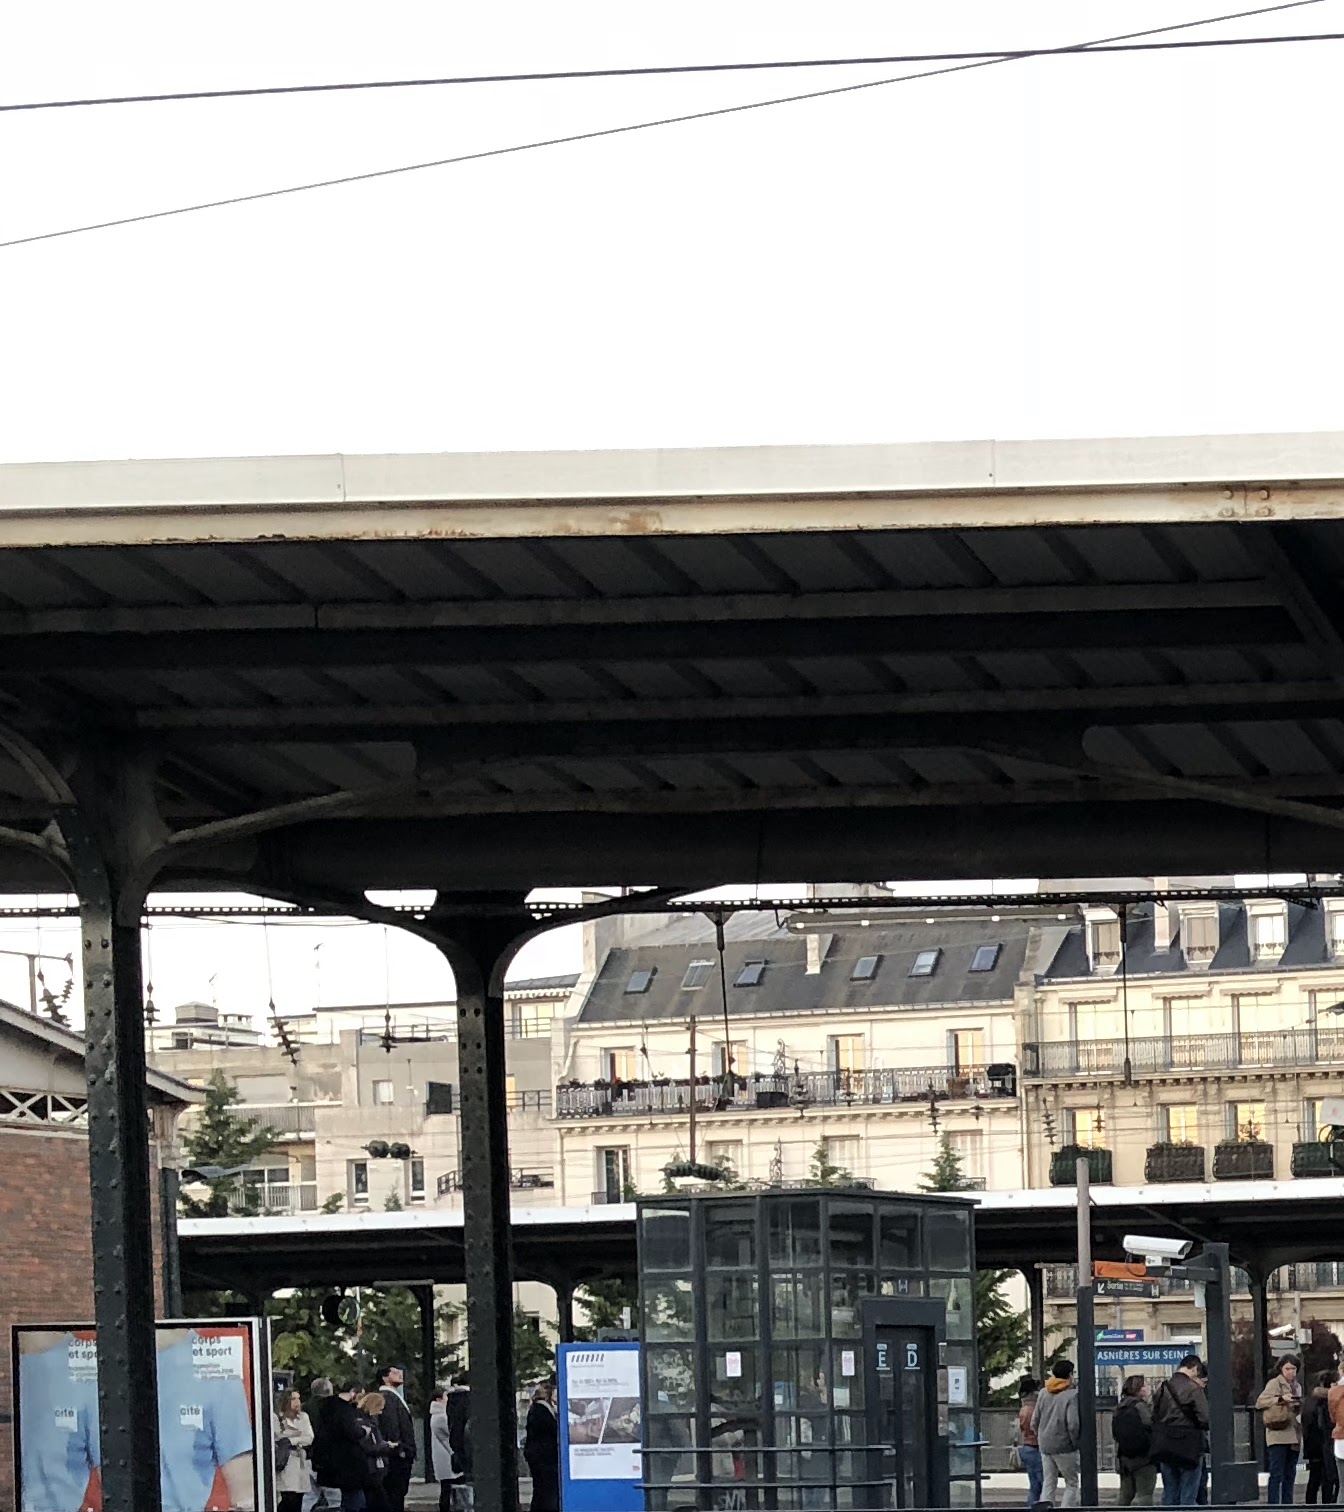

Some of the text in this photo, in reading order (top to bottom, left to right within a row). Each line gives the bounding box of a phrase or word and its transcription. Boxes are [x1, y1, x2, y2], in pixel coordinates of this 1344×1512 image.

[192, 1336, 221, 1347] corps
[68, 1350, 79, 1359] et
[192, 1346, 232, 1358] et sport
[1097, 1350, 1140, 1360] ASNIÈRES
[1143, 1350, 1160, 1360] SUR
[878, 1351, 887, 1367] E
[907, 1350, 918, 1367] D
